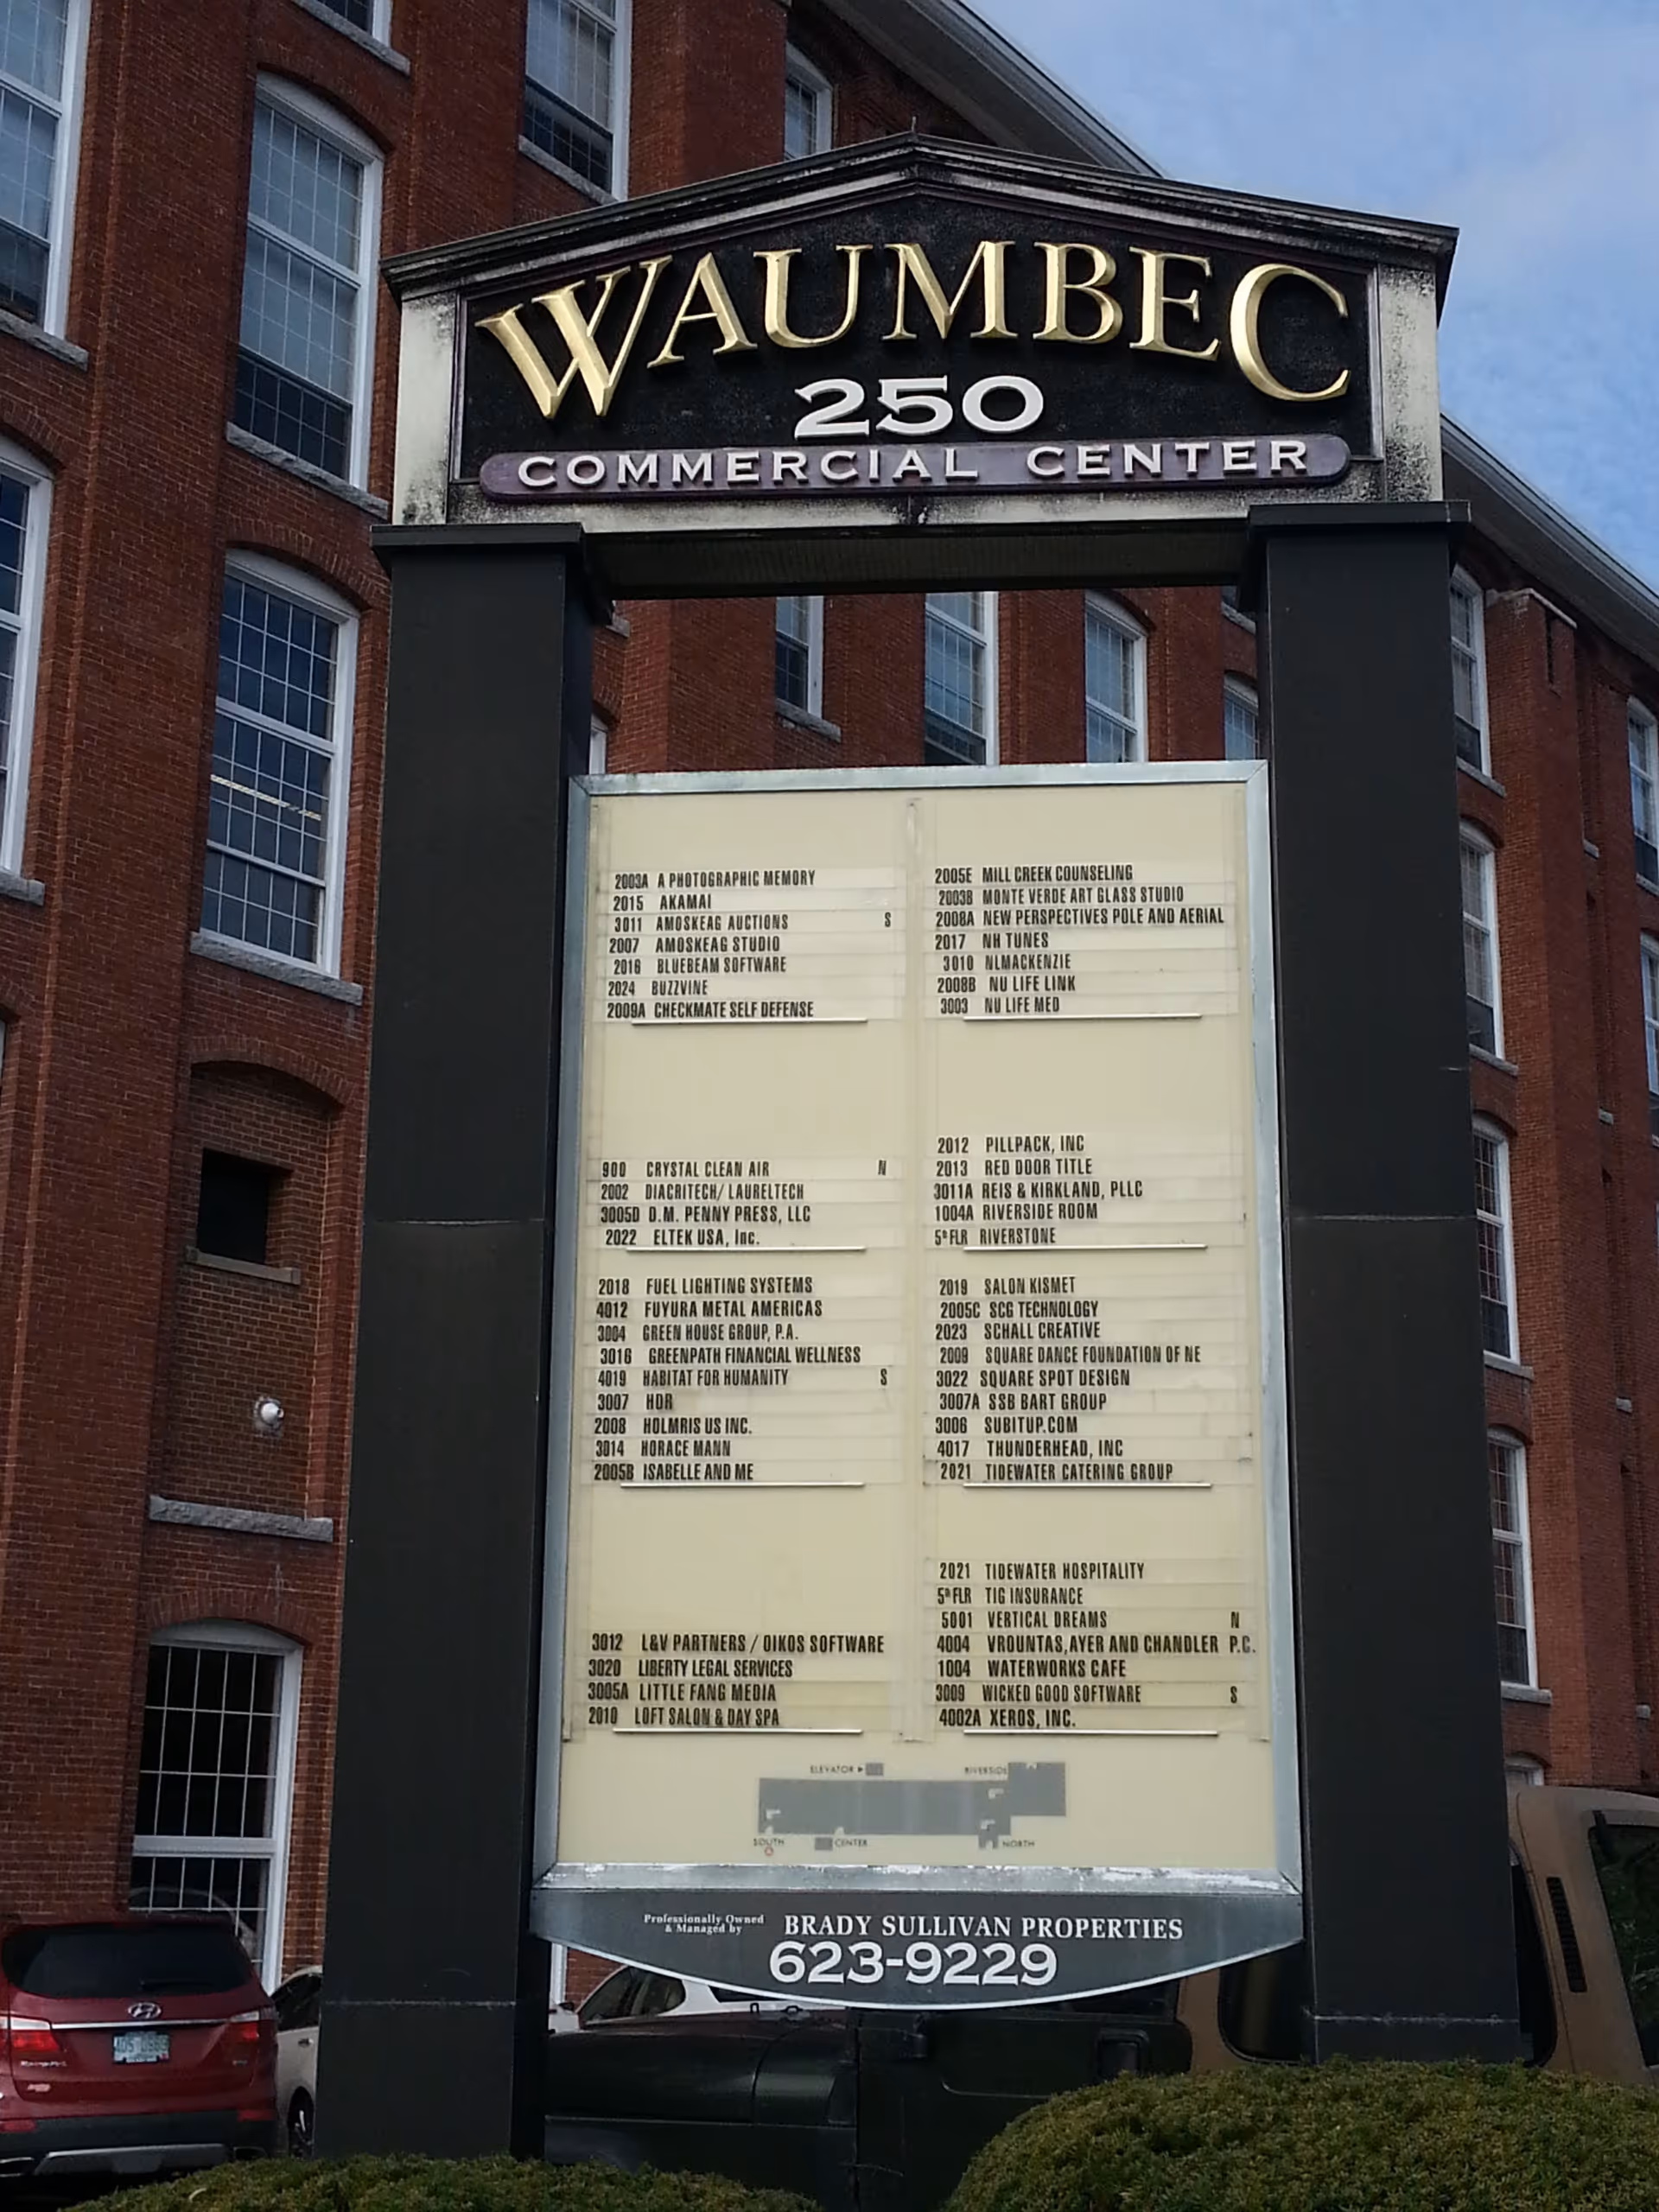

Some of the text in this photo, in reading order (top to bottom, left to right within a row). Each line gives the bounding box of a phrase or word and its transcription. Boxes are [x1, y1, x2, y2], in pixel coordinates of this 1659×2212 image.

[476, 240, 1352, 419] WAUMBEC
[795, 375, 1044, 439] 250
[518, 440, 1307, 487] COMMERCIAL CENTER
[658, 874, 664, 887] A
[670, 871, 759, 887] PHOTOGRAPHIC
[764, 870, 815, 886] MEMORY
[936, 865, 1132, 884] 2005E MILL CREEK COUNSELING
[613, 894, 710, 911] 2015 AKAMAI
[615, 914, 788, 932] 3011 AMOSKEAG AUCTIONS
[937, 908, 1224, 927] 2008A NEW PERSPECTIVES POLE AND AERIAL
[609, 936, 779, 953] 2007 AMOSKEAG STUDIO
[936, 932, 1048, 950] 2017 NH TUNES
[614, 957, 785, 975] 2016 BLUEBEAM SOFTWARE
[608, 980, 707, 996] 2024 BUZZVINE
[938, 976, 1075, 993] 2008B NU LIFE LINK
[607, 1001, 813, 1018] 2009A CHECKMATE SELF DEFENSE
[938, 1135, 1084, 1154] 2012 PILLPACK, INC
[603, 1161, 769, 1177] 900 CRYSTAL CLEAN AIR
[937, 1158, 1091, 1177] 2013 RED DOOR TITLE
[601, 1205, 810, 1224] 3005D D.M. PENNY PRESS, LLC
[936, 1203, 1096, 1221] 1004A RIVERSIDE ROOM
[606, 1229, 760, 1247] 2022 ELTEK USA, Inc.
[599, 1277, 812, 1294] 2018 FUEL LIGHTING SYSTEMS
[940, 1277, 1075, 1295] 2019 SALON KISMET
[596, 1300, 822, 1318] 4012 FUYURA METAL AMERICAS
[941, 1301, 1098, 1319] 2005C SCG TECHNOLOGY
[936, 1322, 1099, 1340] 2023 SCHALL CREATIVE
[601, 1346, 860, 1364] 3016 GREENPATH FINANCIAL WELLNESS
[598, 1369, 788, 1387] 4019 HABITAT FOR HUMANITY
[937, 1370, 1129, 1389] 3022 SQUARE SPOT DESIGN
[598, 1394, 672, 1410] 3007 HDR
[940, 1393, 1106, 1410] 3007A SSB BART GROUP
[594, 1418, 752, 1434] 2008 HOLMRIS US INC.
[936, 1416, 1077, 1433] 3006 SUBITUP.COM
[596, 1440, 730, 1457] 3014 HORACE MANN
[938, 1440, 1122, 1459] 4017 THUNDERHEAD, INC
[941, 1463, 1173, 1480] 2021 TIDEWATER CATERING GROUP
[940, 1562, 1144, 1580] 2021 TIDEWATER HOSPITALITY
[942, 1611, 1106, 1629] 5001 VERTICAL DREAMS
[588, 1659, 792, 1677] 3020 LIBERTY LEGAL SERVICES
[938, 1660, 1125, 1677] 1004 WATERWORKS CAFE
[588, 1682, 776, 1700] 3005A LITTLE FANG MEDIA
[939, 1708, 1075, 1729] 4002A XEROS, INC.
[810, 1764, 854, 1774] ELEVATOR
[964, 1766, 1007, 1775] RIVERSIDE
[753, 1838, 785, 1847] SOUTH
[644, 1913, 765, 1925] Professionally Owned
[785, 1914, 1184, 1940] BRADY SULLIVAN PROPERTIES
[664, 1923, 743, 1936] & Managed by
[769, 1939, 1058, 1986] 623-9229
